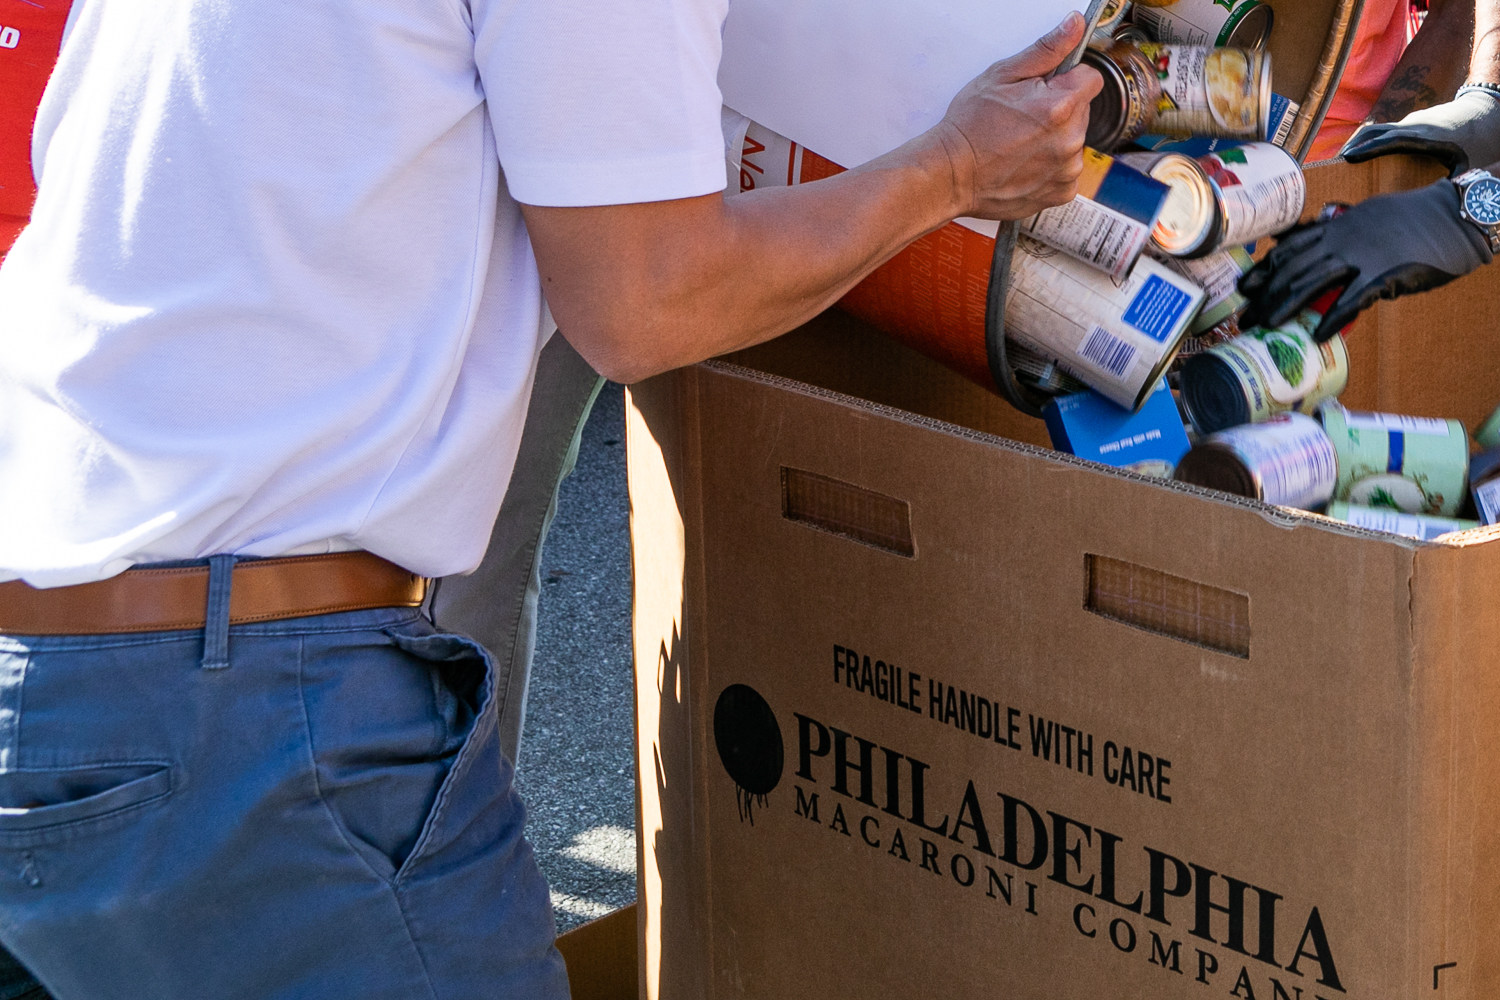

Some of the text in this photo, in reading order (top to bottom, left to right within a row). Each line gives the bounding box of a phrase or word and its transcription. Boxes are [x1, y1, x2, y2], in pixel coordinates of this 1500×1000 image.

[832, 643, 1173, 805] FRAGILE HANDLE WITH CARE
[793, 711, 1348, 994] PHILADELPHIA
[793, 784, 1328, 1000] MACARONI COMPAN
